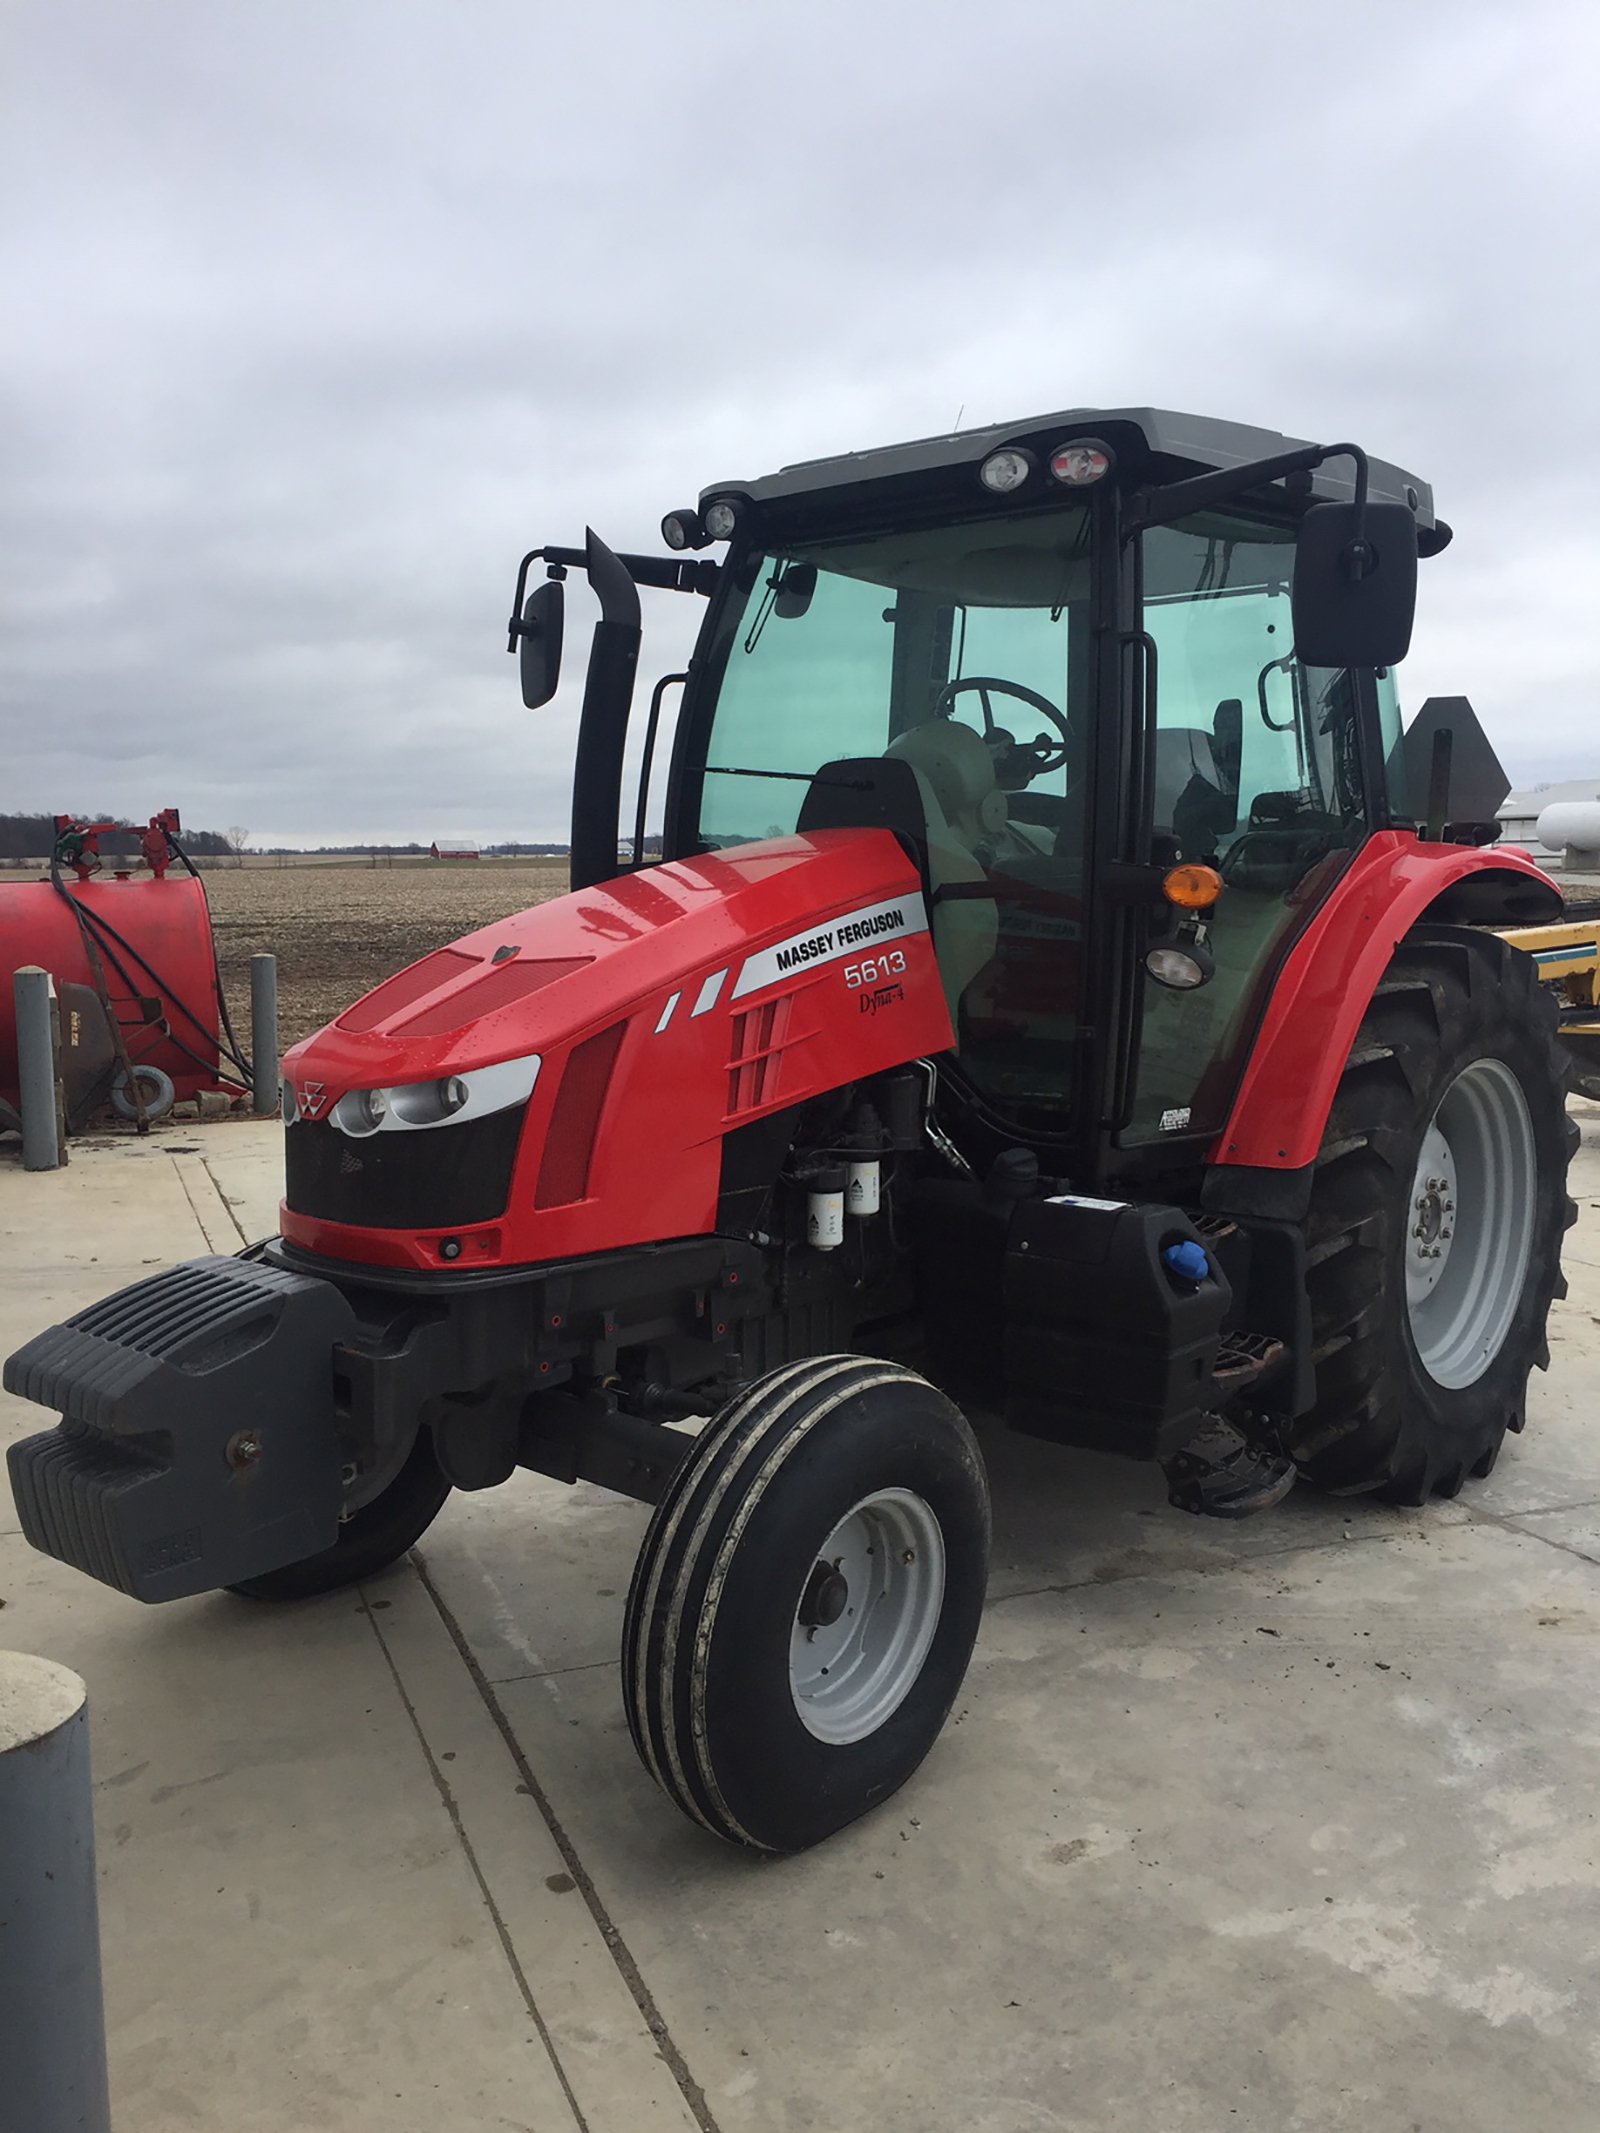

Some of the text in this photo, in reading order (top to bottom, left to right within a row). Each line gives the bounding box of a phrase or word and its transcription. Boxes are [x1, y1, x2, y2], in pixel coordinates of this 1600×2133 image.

[776, 909, 905, 971] MASSEY FERGUSON
[843, 950, 906, 989] 5613
